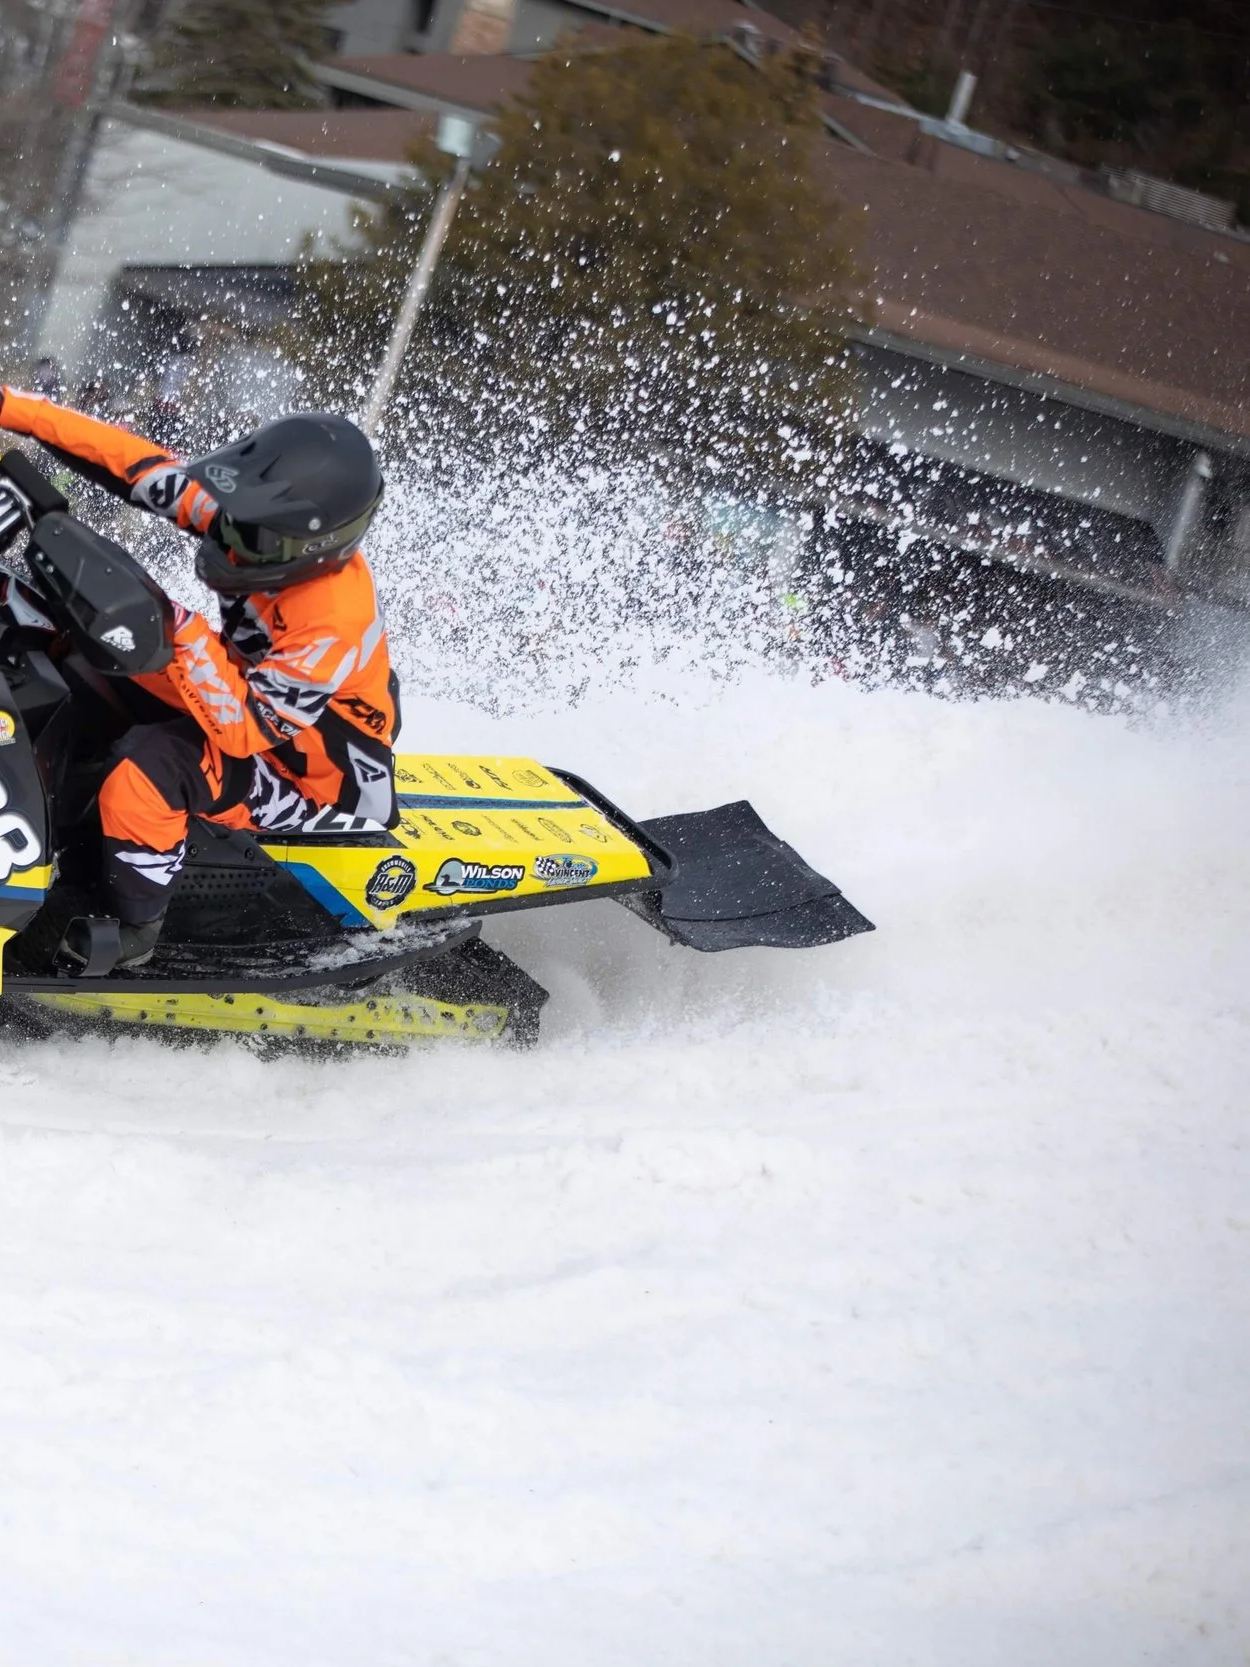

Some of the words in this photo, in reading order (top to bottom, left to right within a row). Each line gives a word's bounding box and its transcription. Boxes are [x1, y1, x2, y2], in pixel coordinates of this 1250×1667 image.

[461, 865, 524, 879] WILSON
[556, 869, 590, 877] VINCENT
[464, 878, 517, 890] PONDS
